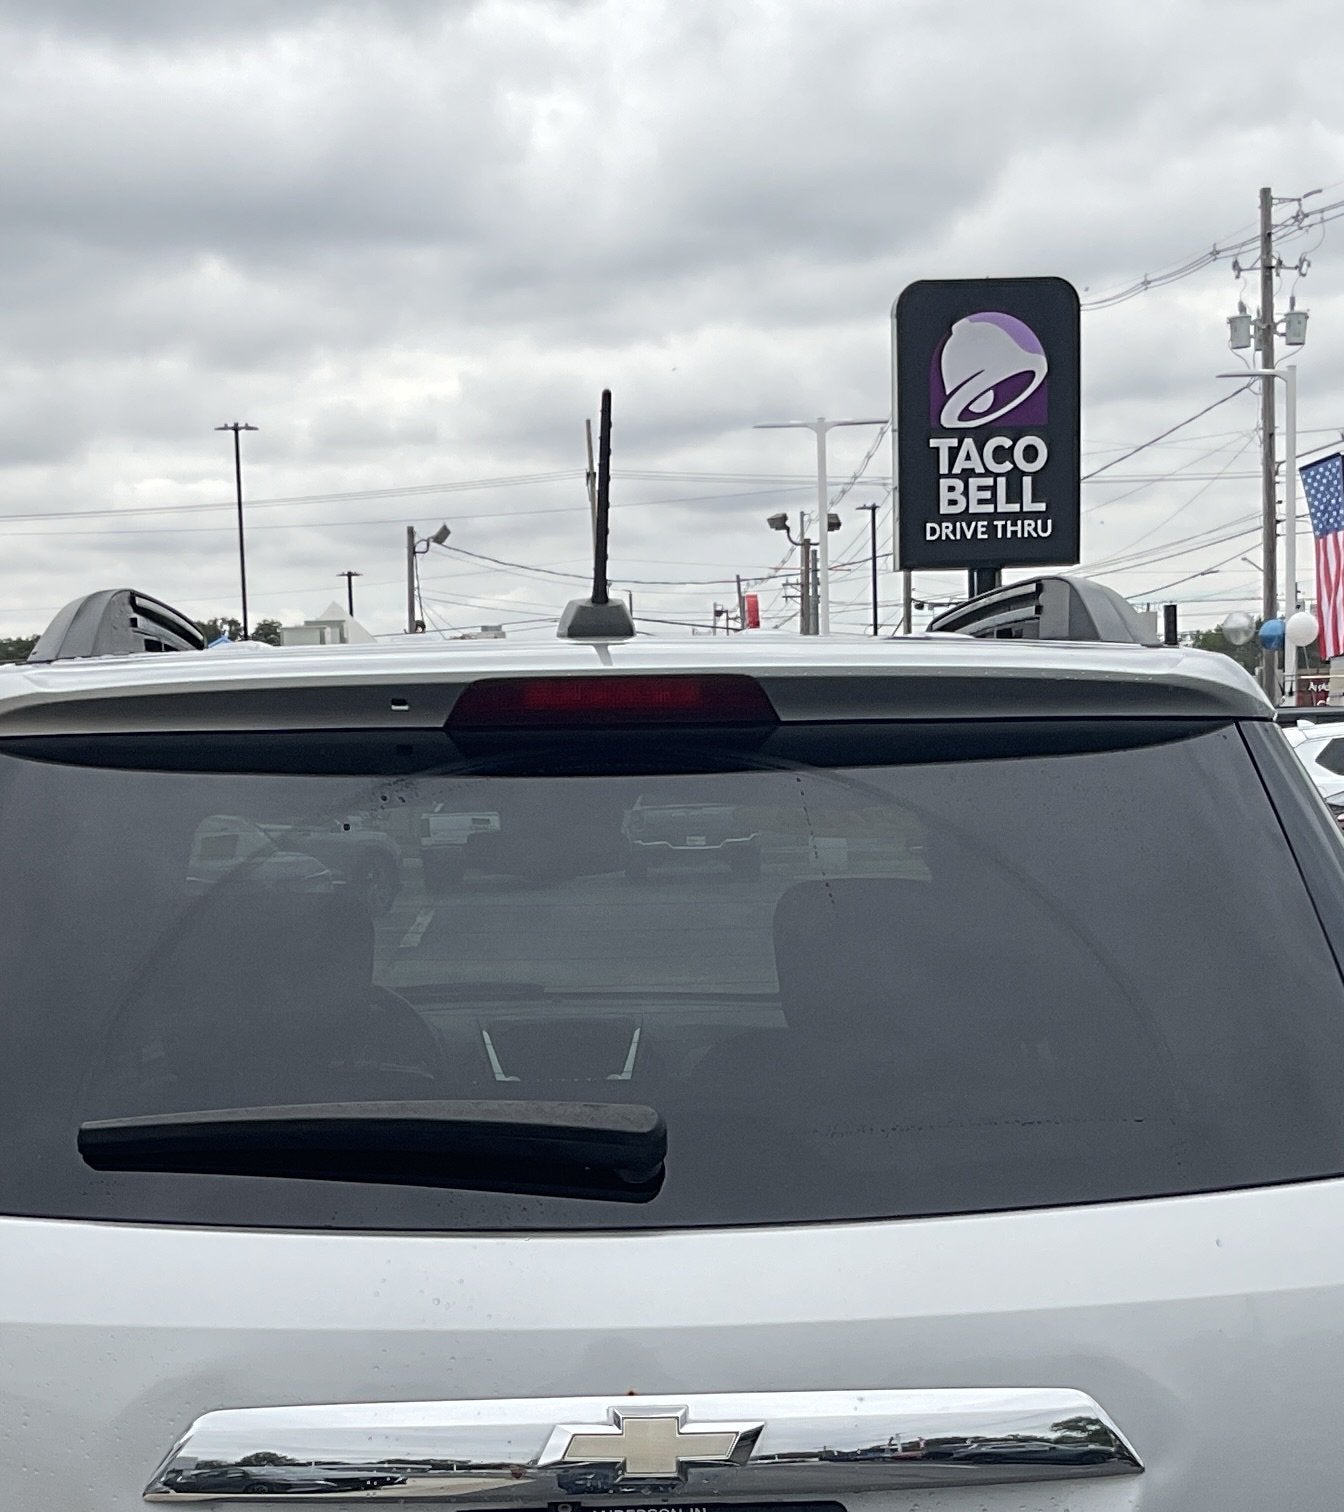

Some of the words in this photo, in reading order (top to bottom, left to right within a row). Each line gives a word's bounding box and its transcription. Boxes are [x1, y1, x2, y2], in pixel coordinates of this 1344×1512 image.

[929, 435, 1048, 474] TACO
[938, 476, 1047, 514] BELL
[925, 520, 989, 541] DRIVE
[993, 518, 1053, 539] THRU
